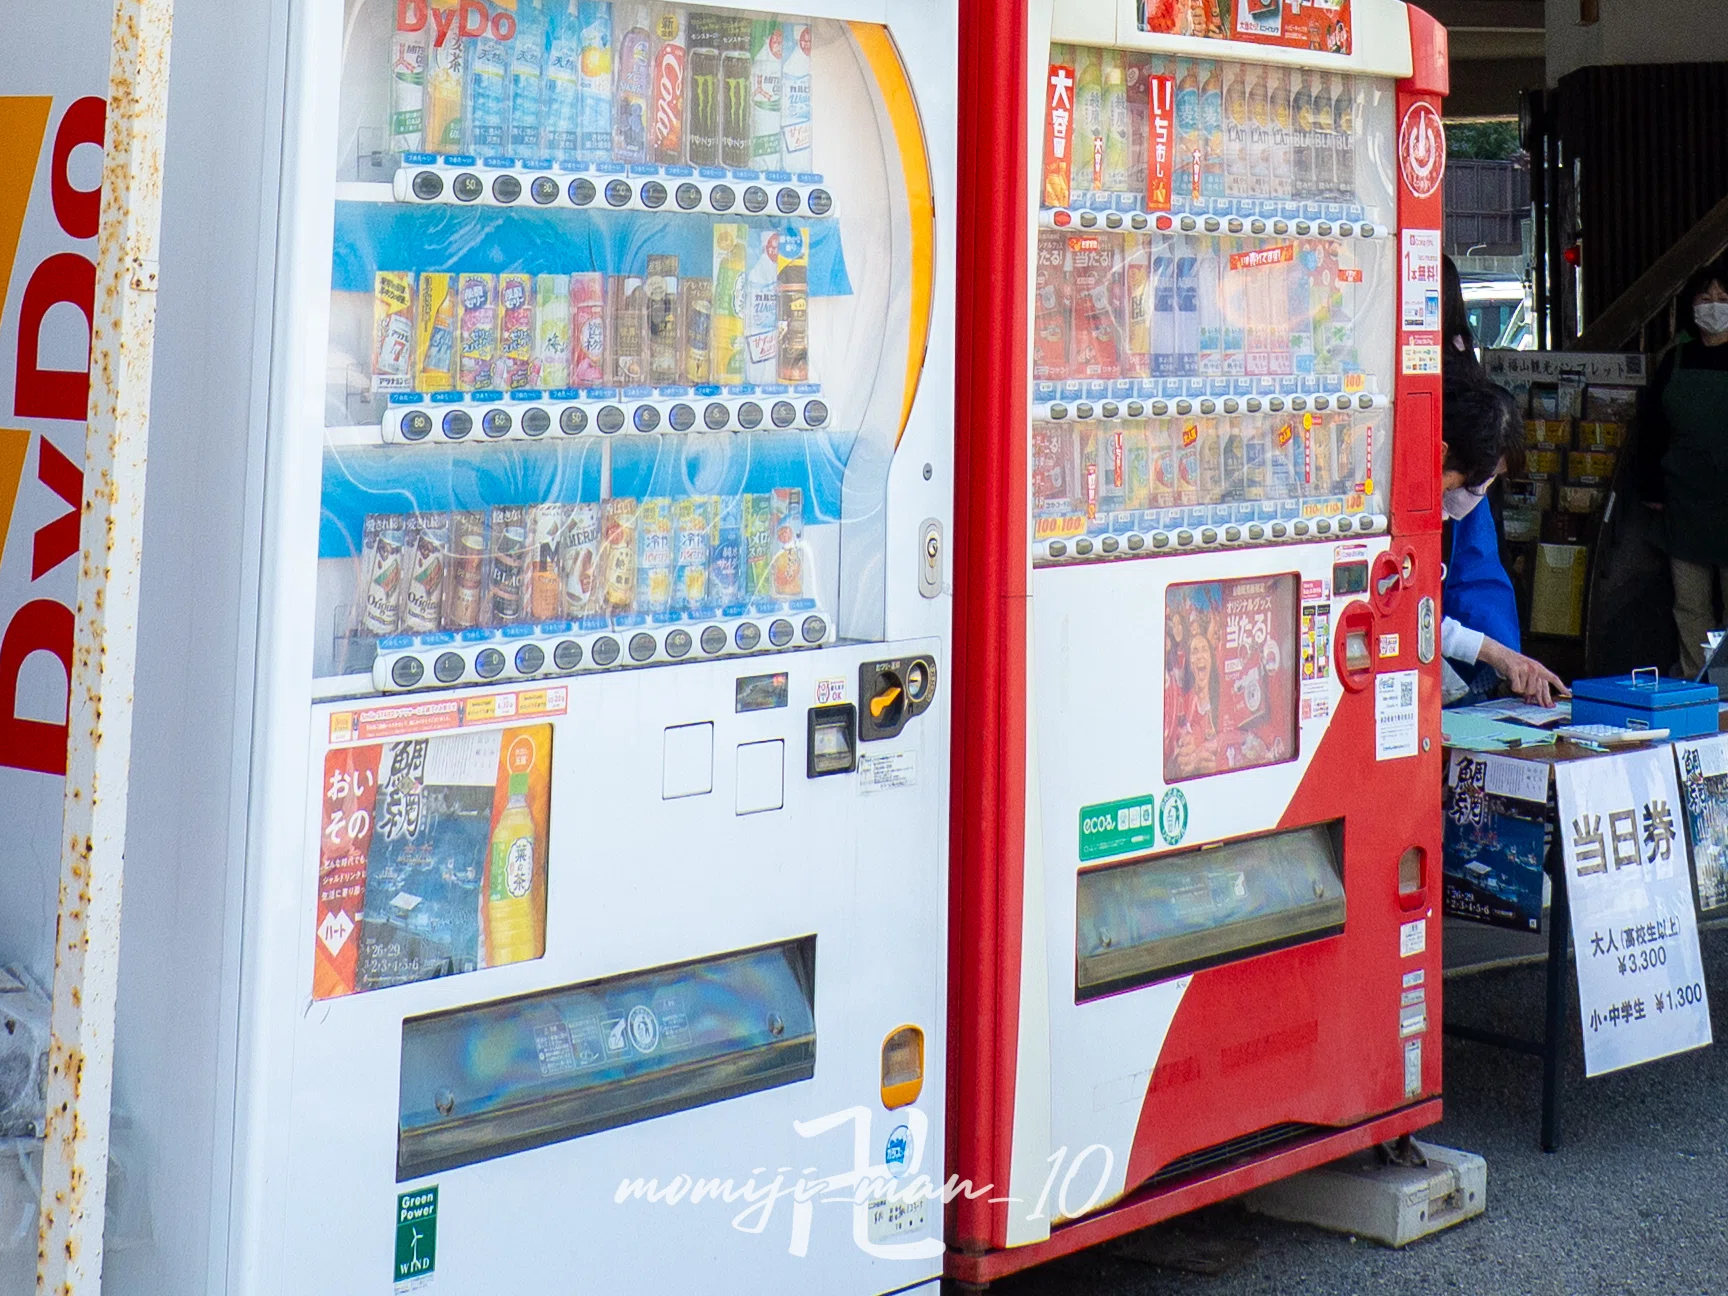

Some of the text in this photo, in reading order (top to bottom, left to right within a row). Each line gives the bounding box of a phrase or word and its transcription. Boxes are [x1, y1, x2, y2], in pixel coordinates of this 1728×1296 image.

[654, 52, 684, 144] Cola
[1226, 612, 1272, 649] 当たる!
[326, 768, 374, 802] おい
[325, 810, 371, 844] その
[1571, 799, 1677, 877] 当日券
[325, 922, 347, 940] ハート
[1617, 945, 1667, 976] ¥3,300
[1589, 982, 1704, 1033] 小・中学生 ¥1,300
[399, 1205, 436, 1223] Power
[400, 1191, 435, 1209] Green
[397, 1255, 432, 1275] WIND
